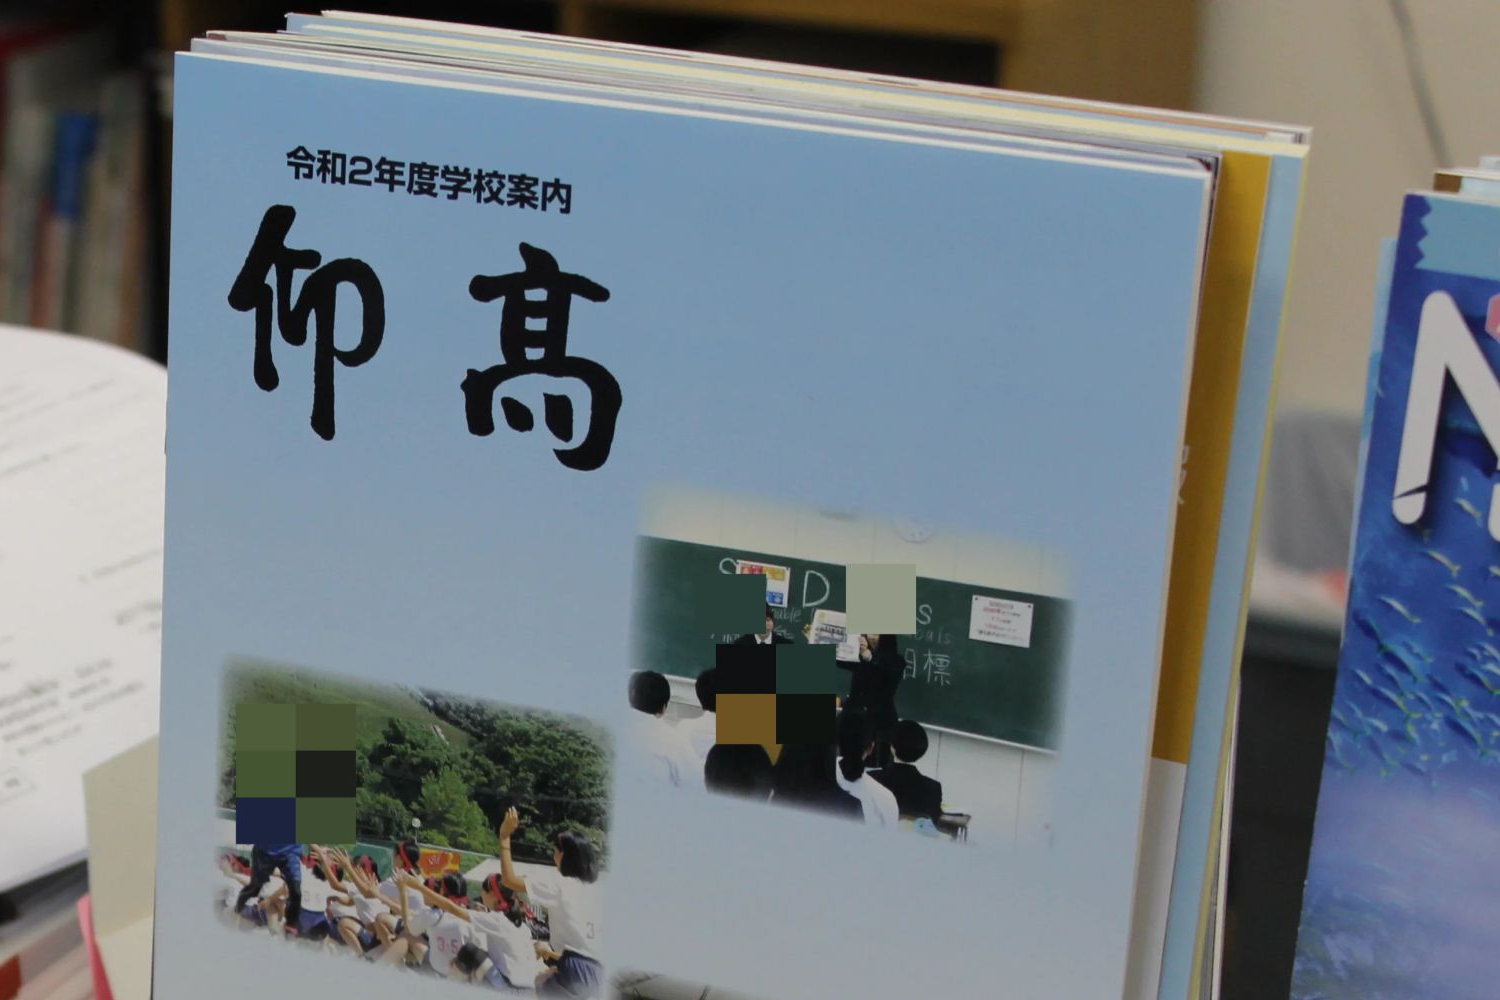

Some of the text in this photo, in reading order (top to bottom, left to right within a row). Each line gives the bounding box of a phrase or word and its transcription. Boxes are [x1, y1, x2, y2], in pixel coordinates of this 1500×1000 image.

[285, 145, 573, 214] 令和2年度学校案内
